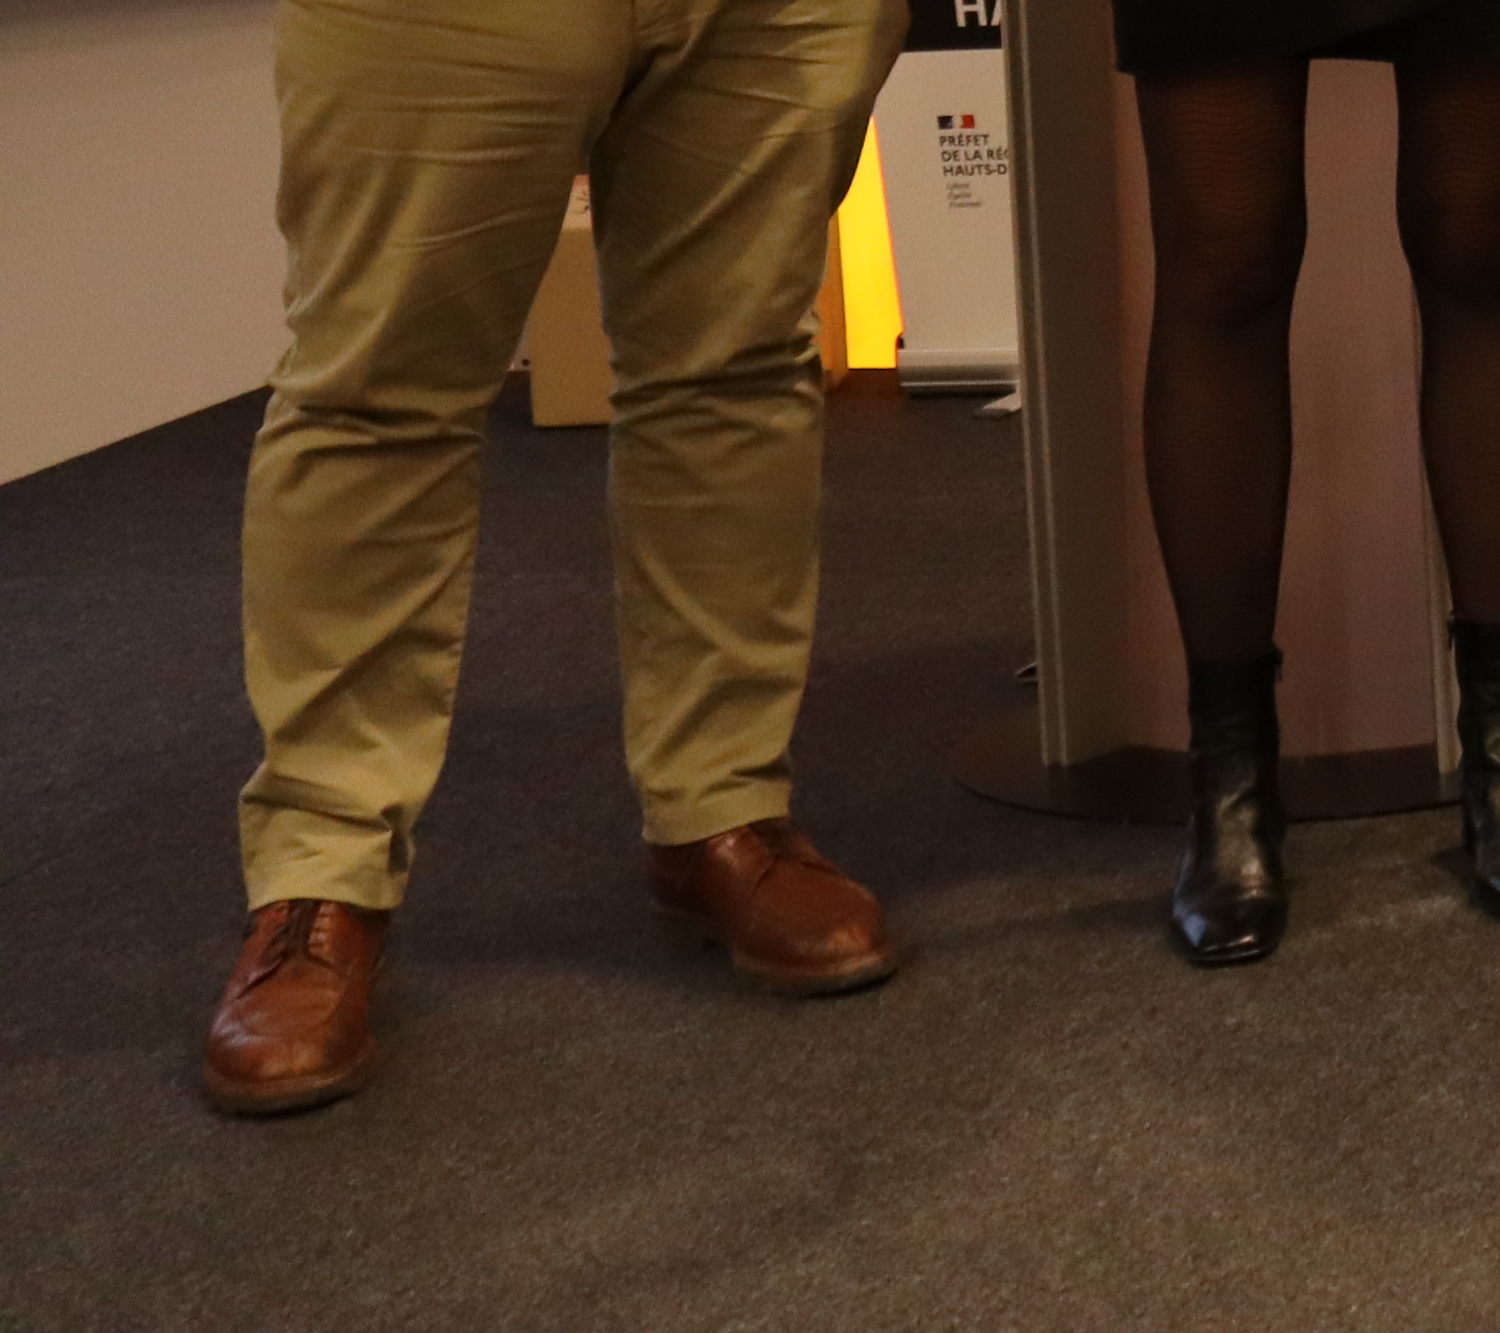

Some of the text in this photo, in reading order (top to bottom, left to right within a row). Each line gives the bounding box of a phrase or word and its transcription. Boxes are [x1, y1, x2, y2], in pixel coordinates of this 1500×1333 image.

[940, 133, 989, 146] PRÉFET
[941, 149, 959, 162] DE
[964, 149, 982, 161] LA
[943, 163, 1007, 176] HAUTS-D
